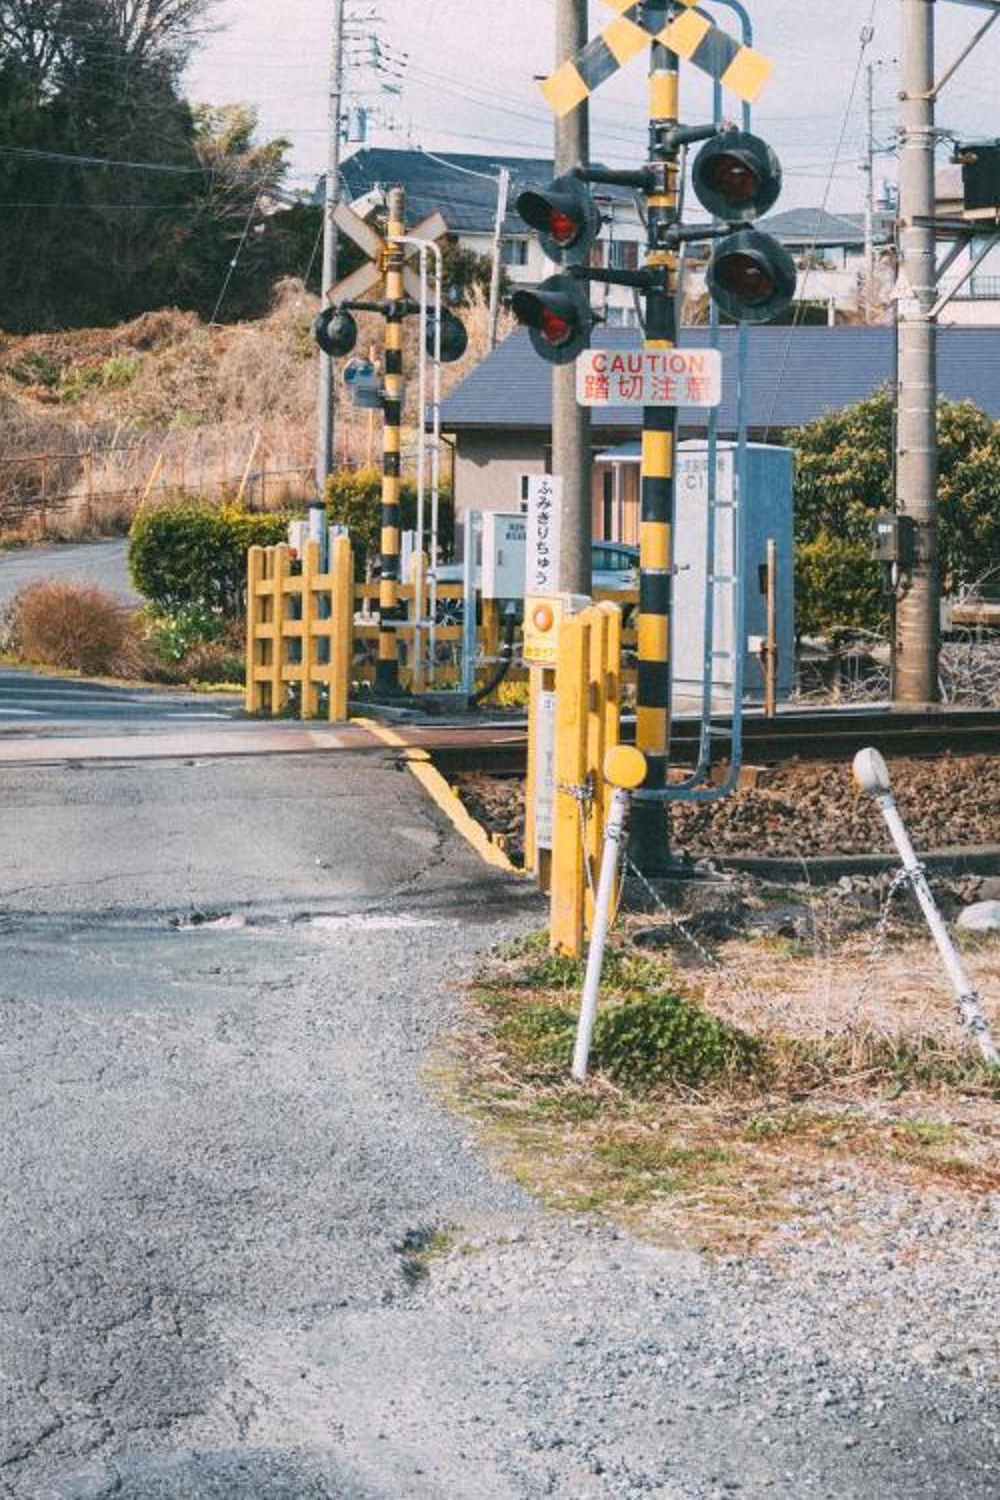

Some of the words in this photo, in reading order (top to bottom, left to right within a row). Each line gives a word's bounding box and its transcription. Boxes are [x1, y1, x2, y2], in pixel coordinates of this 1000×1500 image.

[591, 354, 705, 374] CAUTION
[536, 481, 553, 590] ふみきりちゅう
